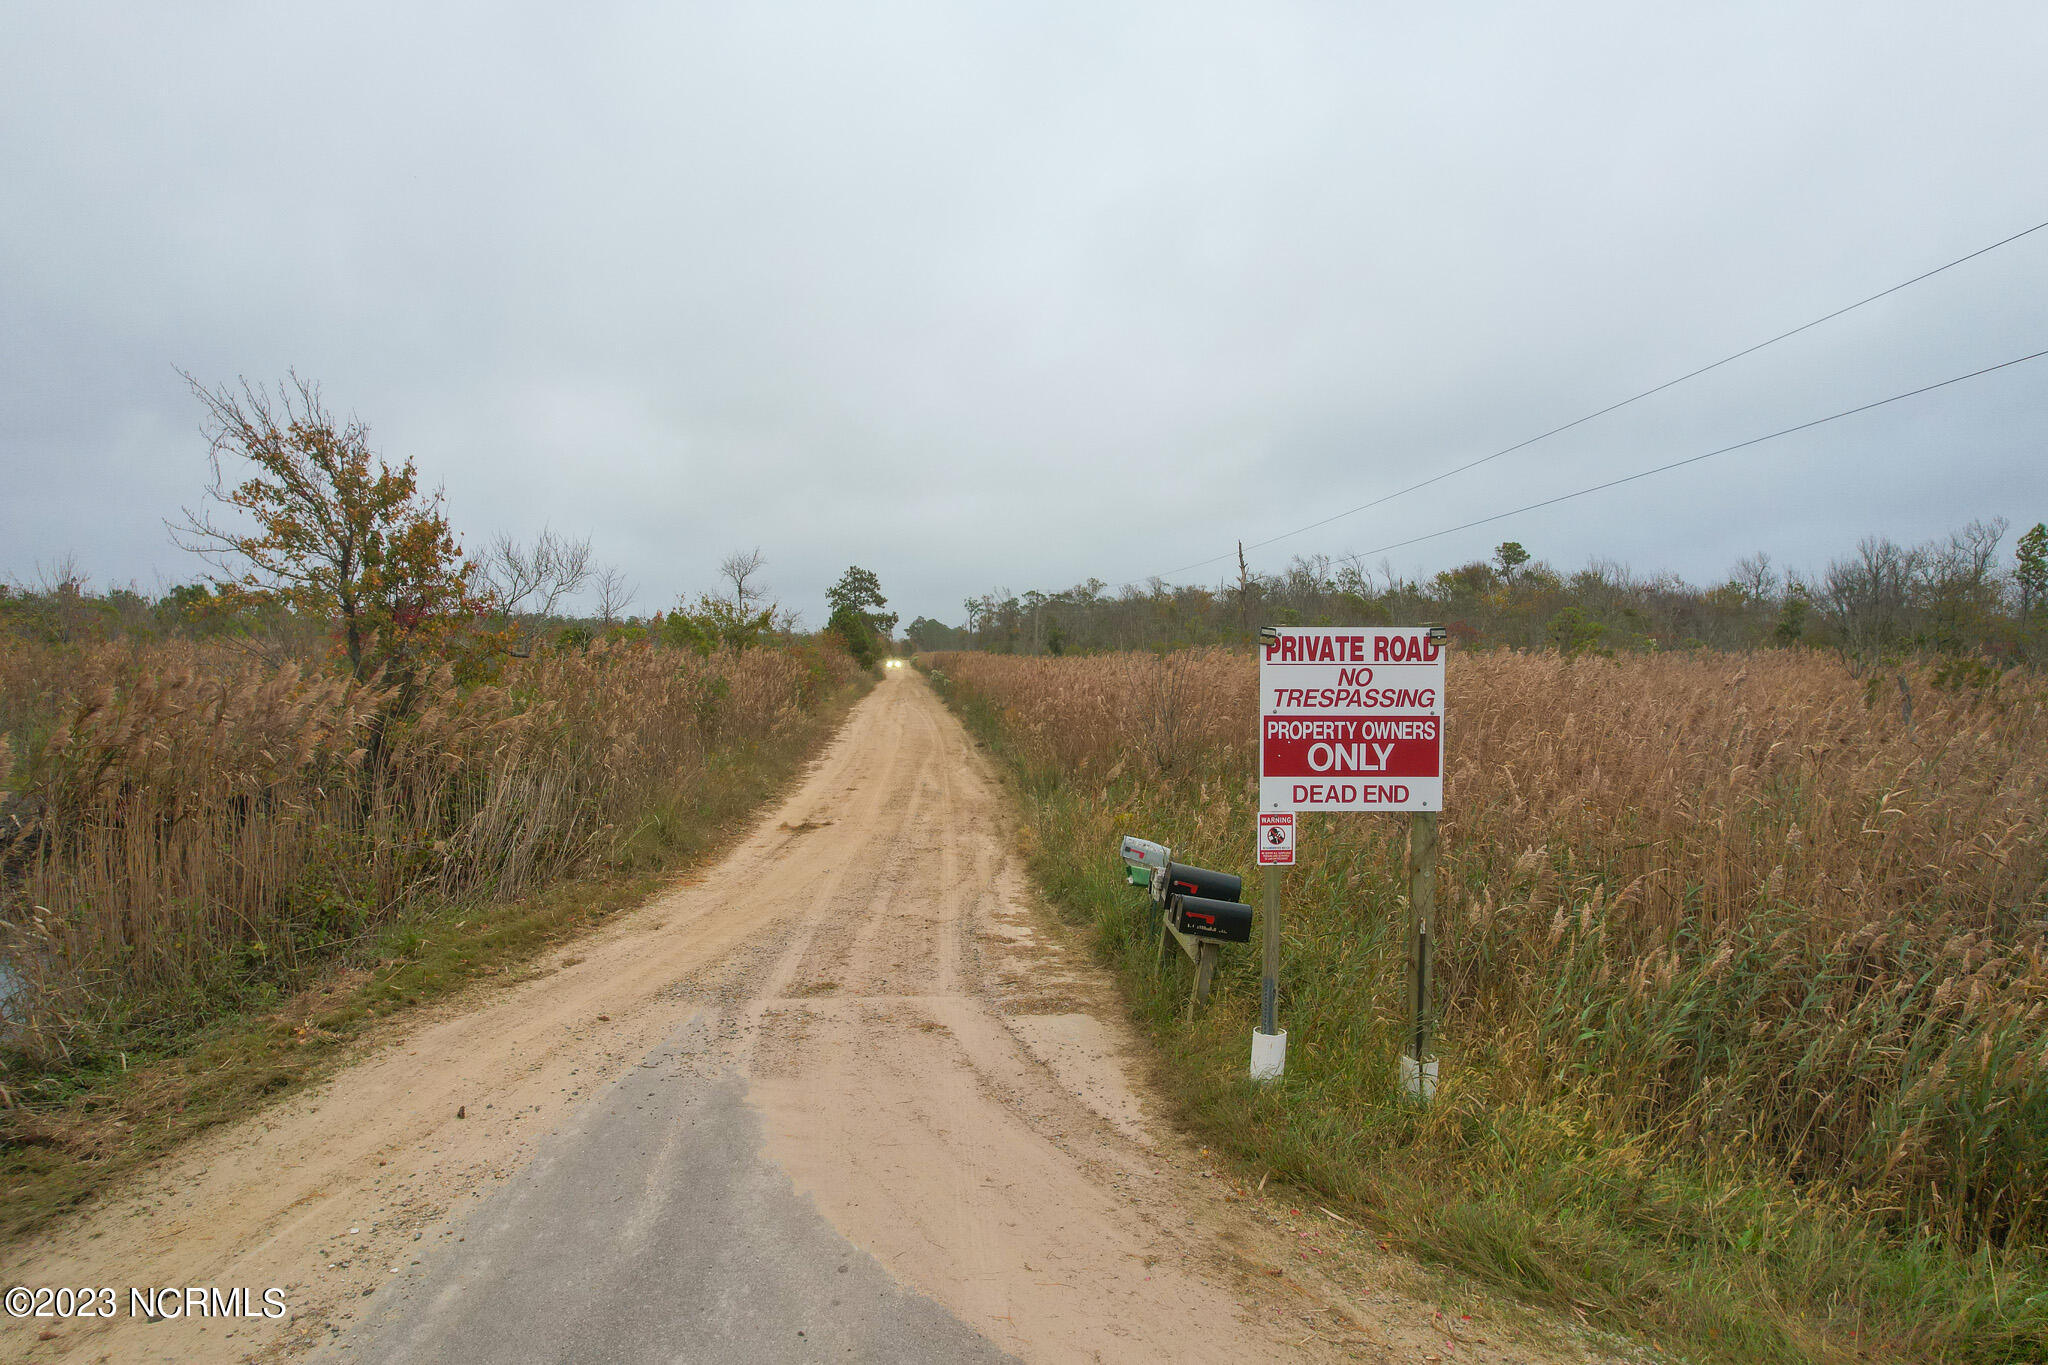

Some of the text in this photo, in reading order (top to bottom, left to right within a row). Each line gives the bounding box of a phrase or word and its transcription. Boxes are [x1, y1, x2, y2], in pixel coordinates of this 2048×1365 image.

[1266, 636, 1440, 662] PRIVATE ROAD
[1338, 668, 1373, 687] NO
[1274, 688, 1436, 708] TRESPASSING
[1267, 721, 1436, 740] PROPERTY OWNERS
[1307, 743, 1395, 771] ONLY
[1292, 784, 1410, 803] DEAD END
